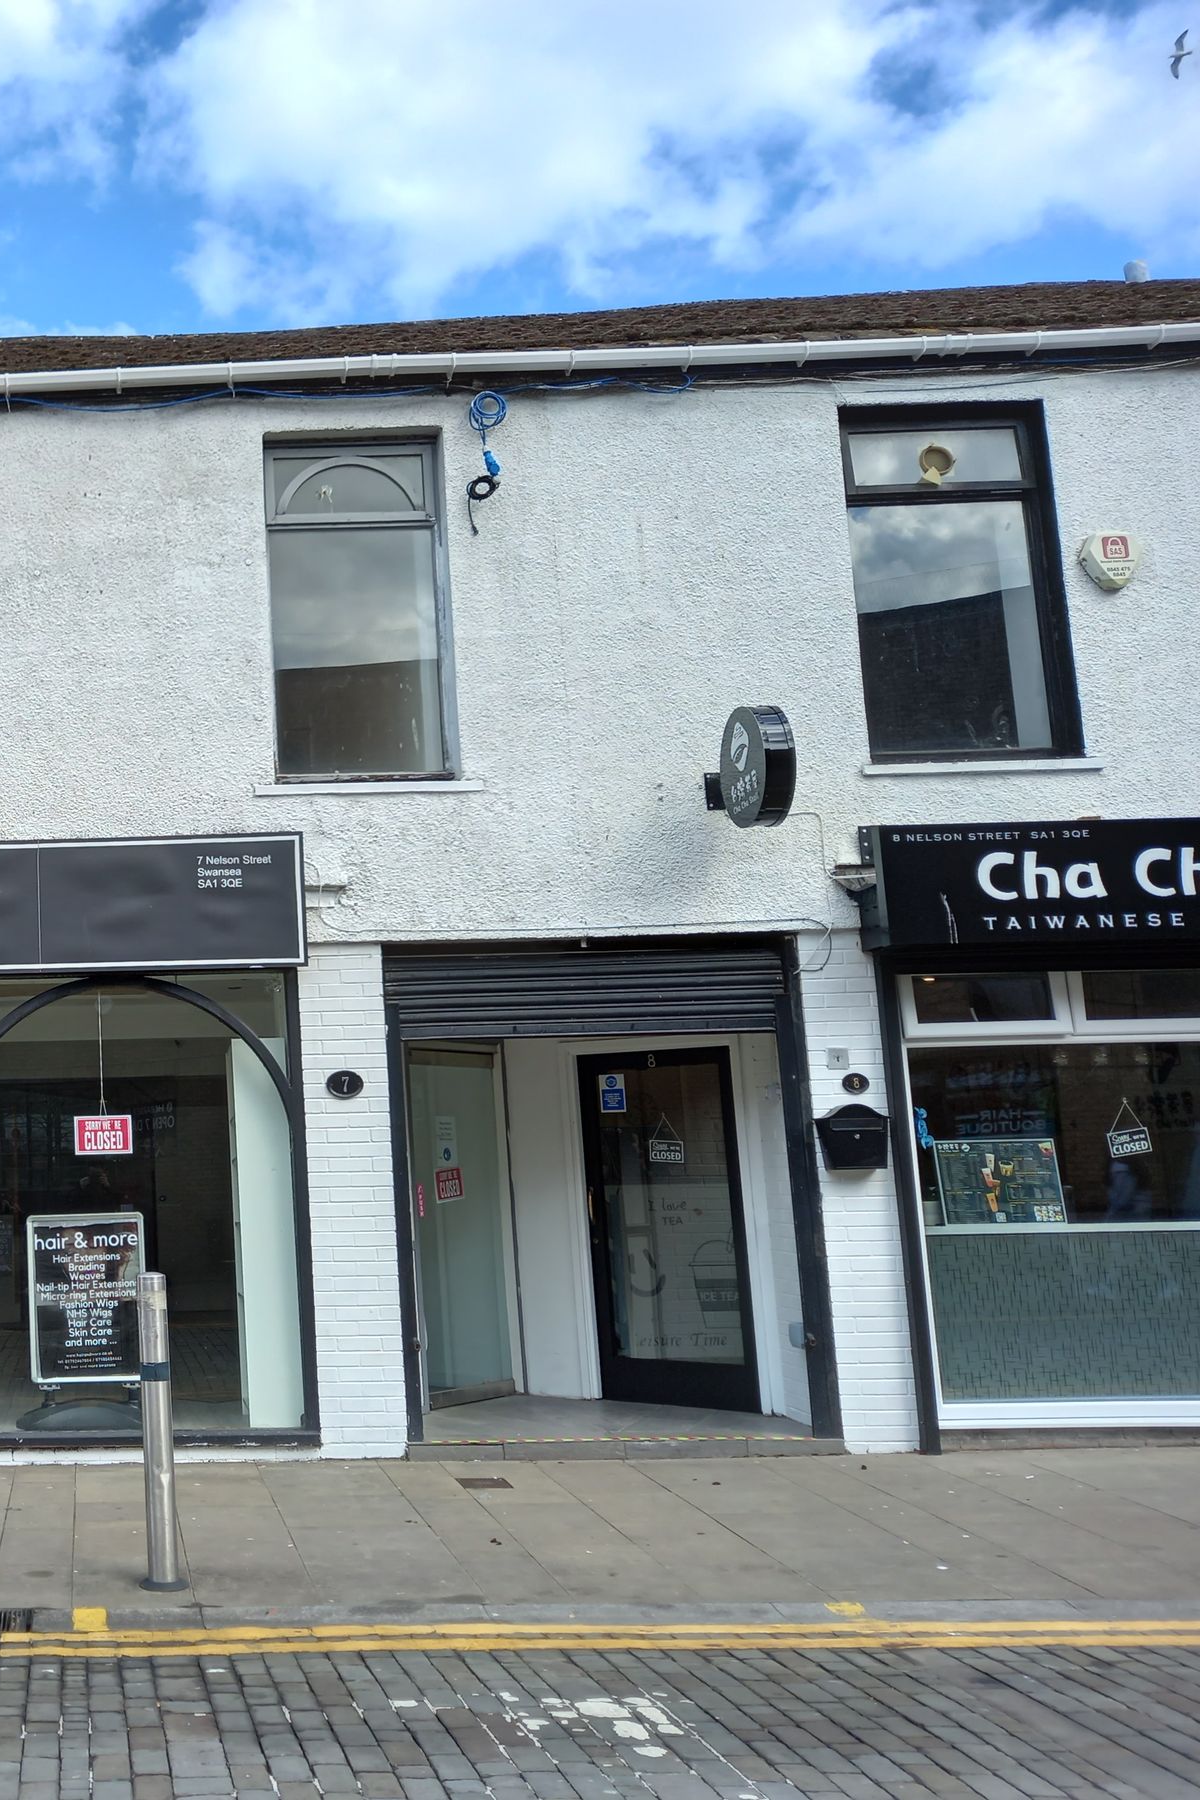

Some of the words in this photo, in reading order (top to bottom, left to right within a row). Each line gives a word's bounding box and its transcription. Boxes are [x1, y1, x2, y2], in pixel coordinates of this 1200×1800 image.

[892, 834, 900, 842] 8
[906, 832, 963, 842] NELSON
[968, 831, 1020, 840] STREET
[1030, 830, 1056, 840] SA1
[1062, 830, 1090, 838] 3QE
[196, 856, 204, 865] 7
[206, 856, 240, 864] Nelson
[242, 854, 272, 864] Street
[197, 868, 242, 876] Swansea
[977, 850, 1108, 901] Cha
[1134, 847, 1200, 897] Ch
[198, 879, 218, 888] SA1
[220, 878, 243, 888] 3QE
[984, 912, 1185, 930] TAIWANESE
[648, 1054, 656, 1068] 8
[342, 1076, 350, 1092] 7
[854, 1078, 860, 1088] 8
[85, 1121, 101, 1130] SORRY
[84, 1130, 123, 1150] CLOSED
[1113, 1140, 1148, 1154] CLOSED
[652, 1151, 681, 1160] CLOSED
[662, 1216, 684, 1226] TEA
[34, 1233, 69, 1250] hair
[74, 1232, 88, 1249] &
[94, 1232, 138, 1248] more
[52, 1254, 71, 1264] Hair
[74, 1252, 121, 1262] Extensions
[68, 1262, 106, 1272] Braiding
[69, 1272, 106, 1280] Weaves
[36, 1282, 70, 1292] Nail-tip
[71, 1282, 90, 1290] Hair
[40, 1291, 87, 1300] Micro-ring
[89, 1289, 136, 1298] Extensions
[60, 1300, 94, 1310] Fashion
[96, 1299, 118, 1309] Wigs
[66, 1309, 88, 1318] NHS
[90, 1308, 112, 1318] Wigs
[68, 1319, 88, 1328] Hair
[90, 1318, 112, 1327] Care
[68, 1328, 88, 1338] Skin
[90, 1328, 112, 1336] Care
[64, 1338, 82, 1347] and
[84, 1337, 108, 1346] more
[638, 1336, 682, 1347] eisure
